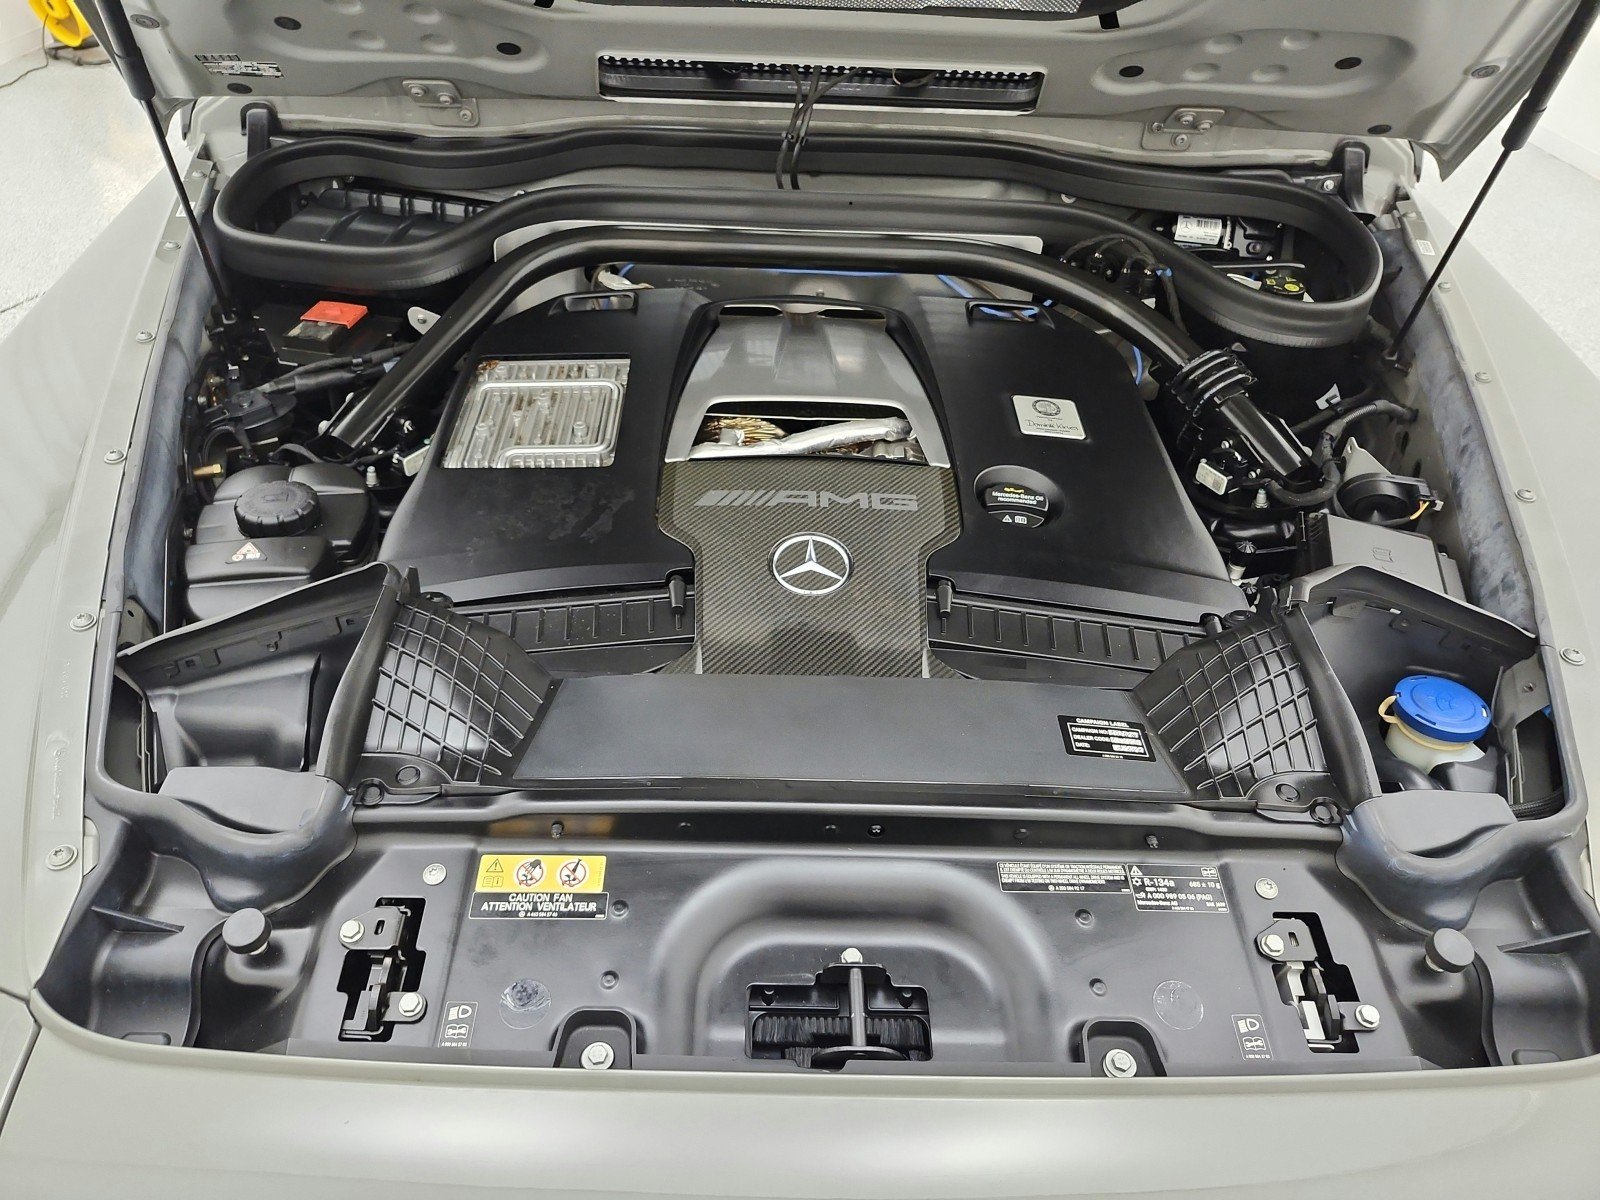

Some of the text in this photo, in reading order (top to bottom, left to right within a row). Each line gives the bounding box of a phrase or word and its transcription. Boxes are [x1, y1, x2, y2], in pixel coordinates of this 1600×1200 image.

[992, 491, 1034, 500] Mercedes-Benz
[766, 490, 918, 511] AMG
[997, 497, 1037, 505] recommended
[1076, 717, 1109, 726] CAMPAIGN
[1143, 877, 1175, 887] R-134a
[508, 893, 573, 902] CAUTION FAN
[480, 902, 597, 912] ATTENTION VENTILATEUR
